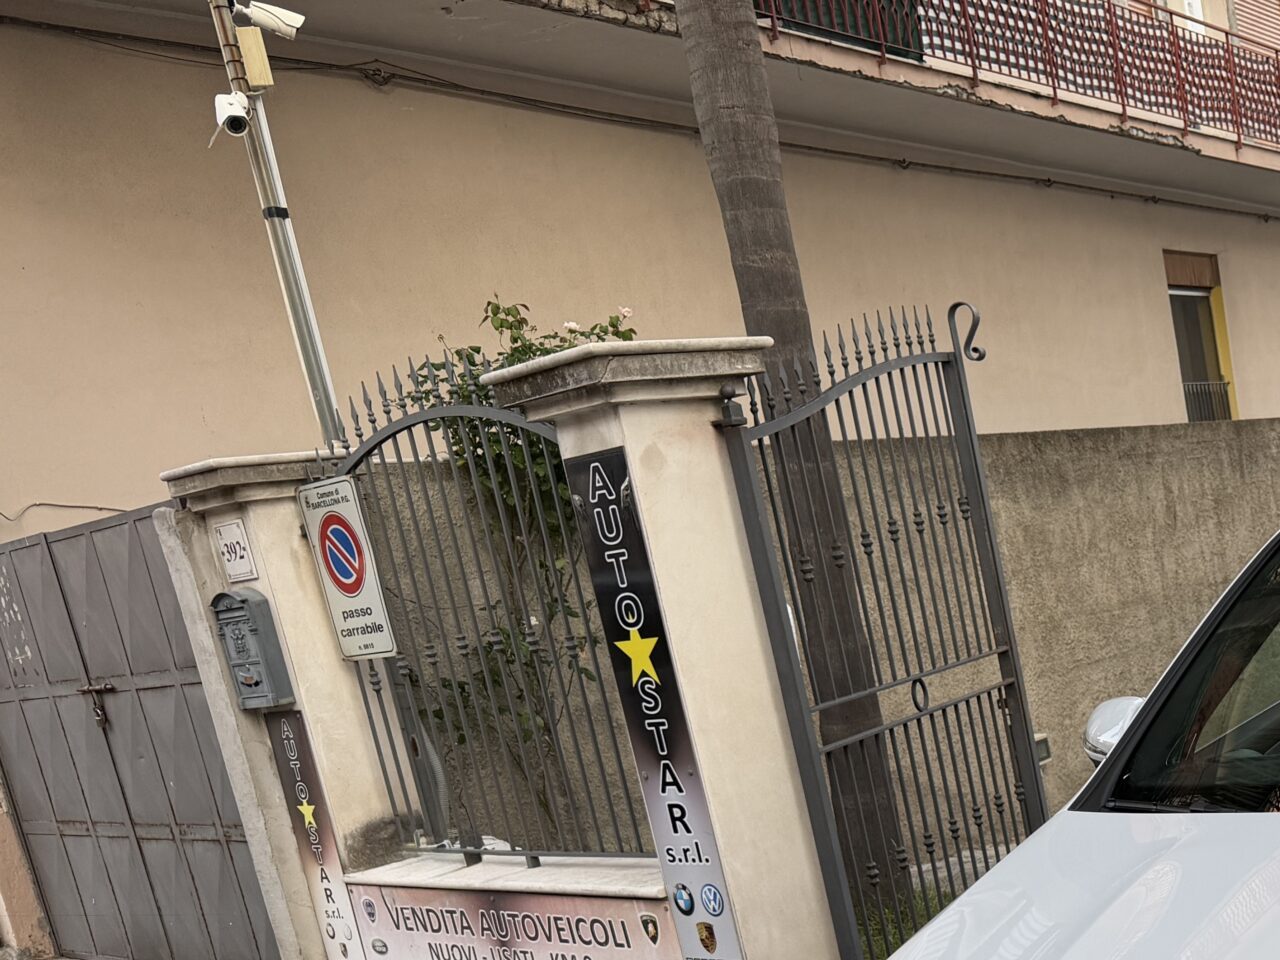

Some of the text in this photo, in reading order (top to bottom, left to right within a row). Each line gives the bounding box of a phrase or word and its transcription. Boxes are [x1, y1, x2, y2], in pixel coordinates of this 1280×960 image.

[223, 540, 245, 562] 392
[589, 462, 644, 631] AUTO
[340, 622, 384, 638] carrabile
[342, 606, 372, 622] passo
[281, 718, 309, 801] AUTO
[638, 677, 693, 835] STAR
[307, 824, 336, 904] STAR
[665, 841, 710, 864] s.r.l.
[325, 908, 344, 920] s.r.l.
[387, 905, 632, 949] VENDITA AUTOVEICOLI
